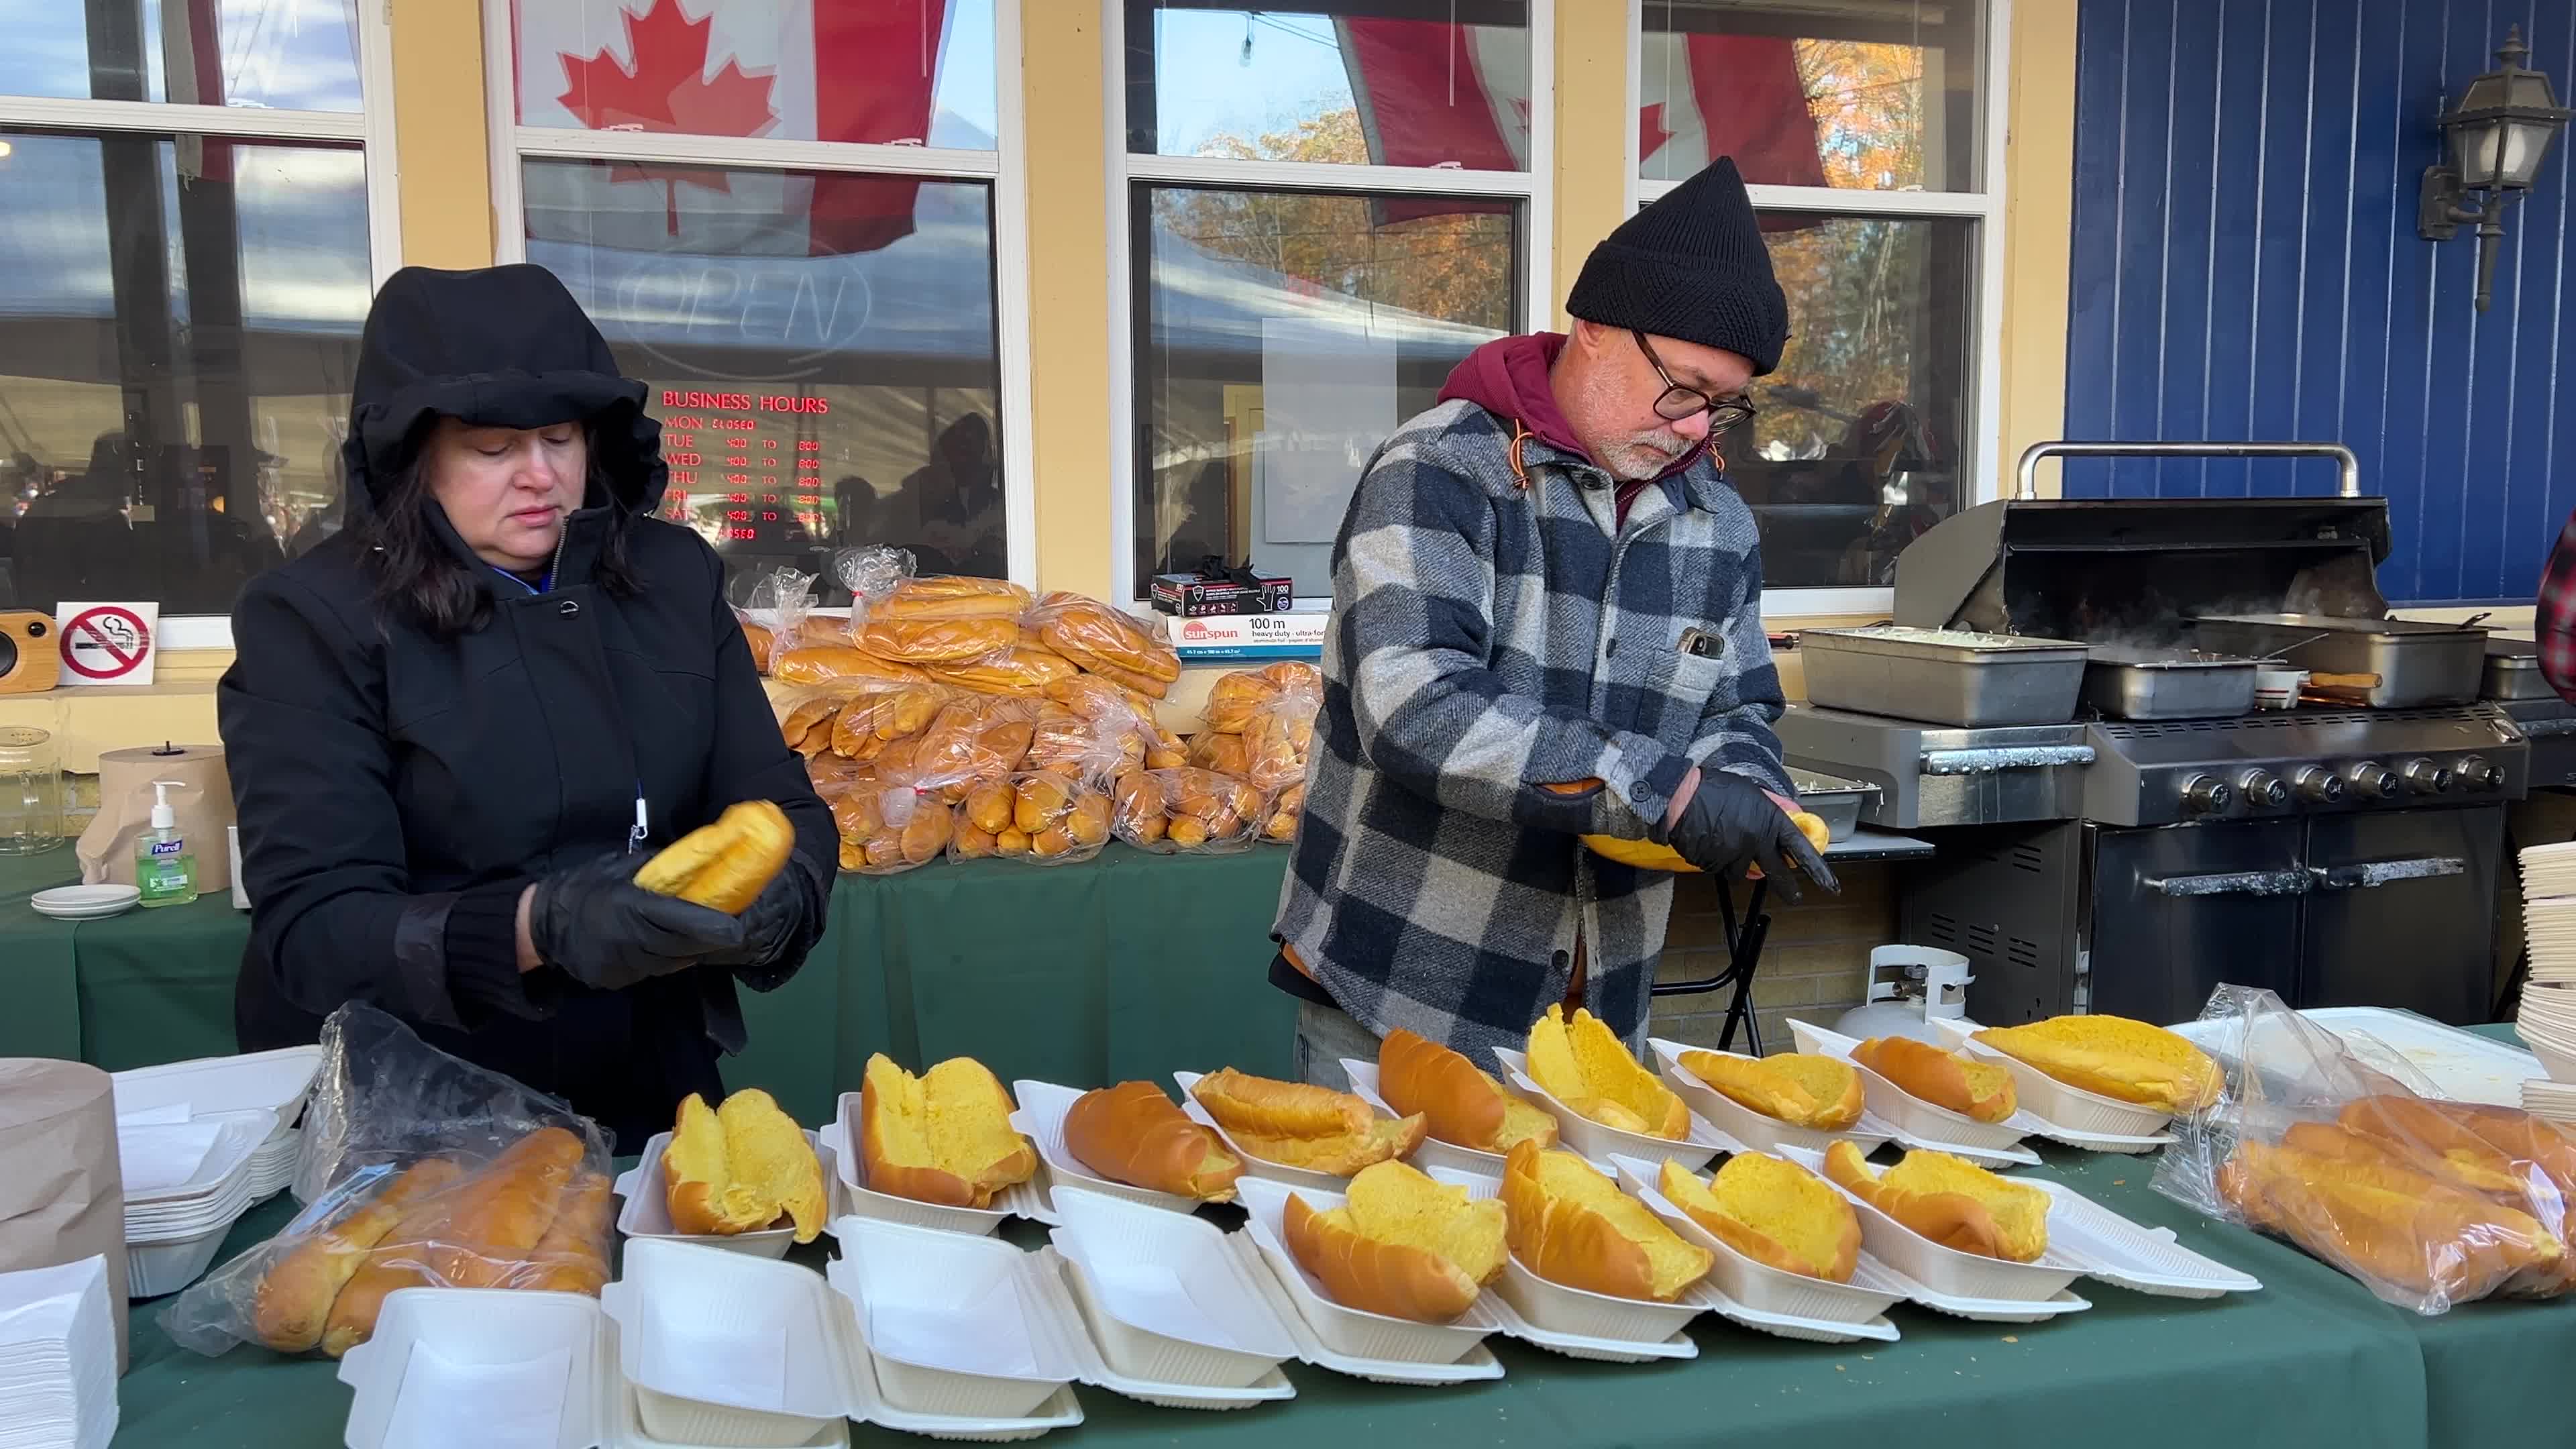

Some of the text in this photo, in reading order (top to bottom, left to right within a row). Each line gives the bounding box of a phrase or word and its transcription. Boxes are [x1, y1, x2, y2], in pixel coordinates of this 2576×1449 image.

[633, 266, 848, 341] OPEN
[662, 391, 829, 414] BUSINESS HOURS
[664, 415, 754, 430] MON CLOSED
[663, 434, 693, 447] TUE
[762, 440, 777, 449] TO
[665, 452, 701, 466] WED
[762, 458, 777, 467] TO
[762, 476, 777, 484] TO
[762, 494, 777, 503] TO
[665, 506, 690, 521] SAT
[762, 513, 777, 521] TO
[1249, 618, 1285, 629] 100 m
[1185, 629, 1240, 640] sunspun
[155, 843, 180, 853] Purell
